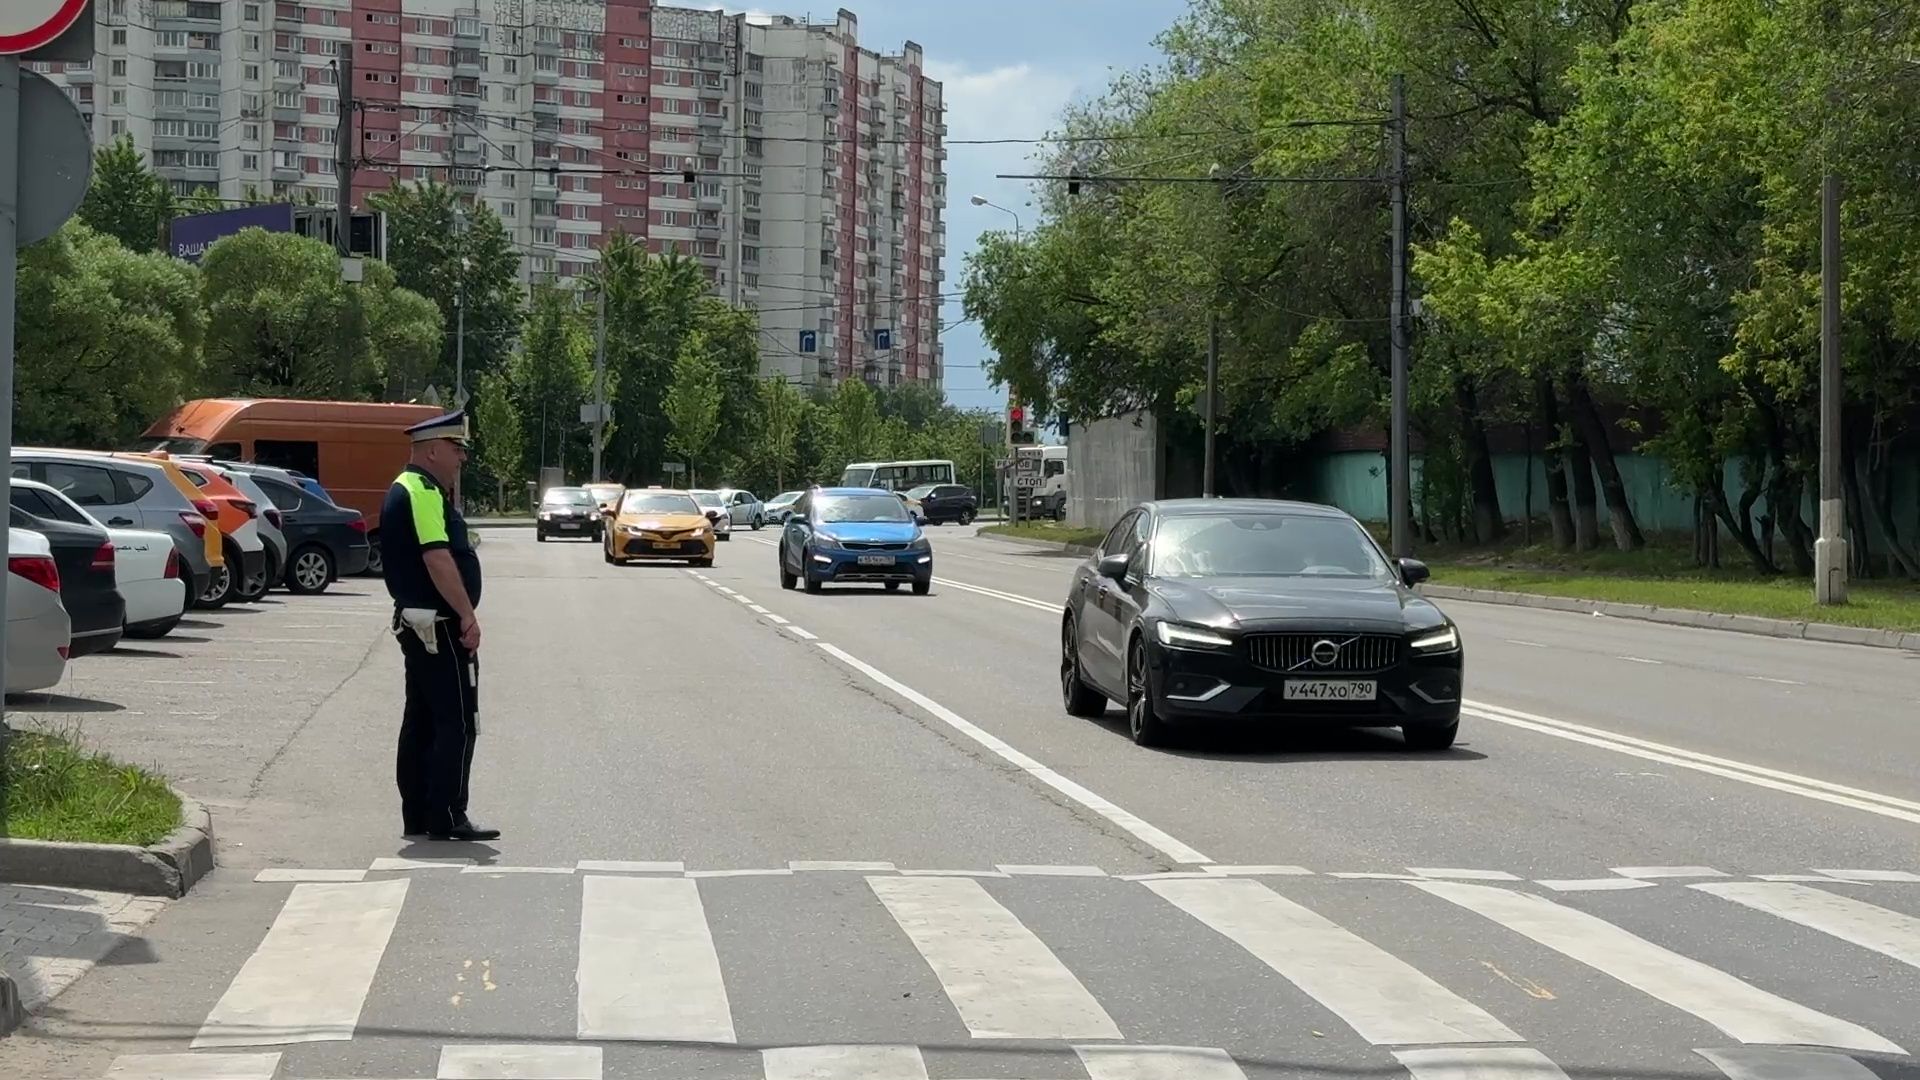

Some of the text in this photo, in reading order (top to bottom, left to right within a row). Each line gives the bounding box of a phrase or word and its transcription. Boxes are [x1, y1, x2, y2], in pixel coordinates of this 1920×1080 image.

[178, 242, 205, 257] ВАША
[1017, 478, 1042, 487] СТОП
[1289, 683, 1348, 698] У447ХО
[1350, 682, 1373, 694] 790
